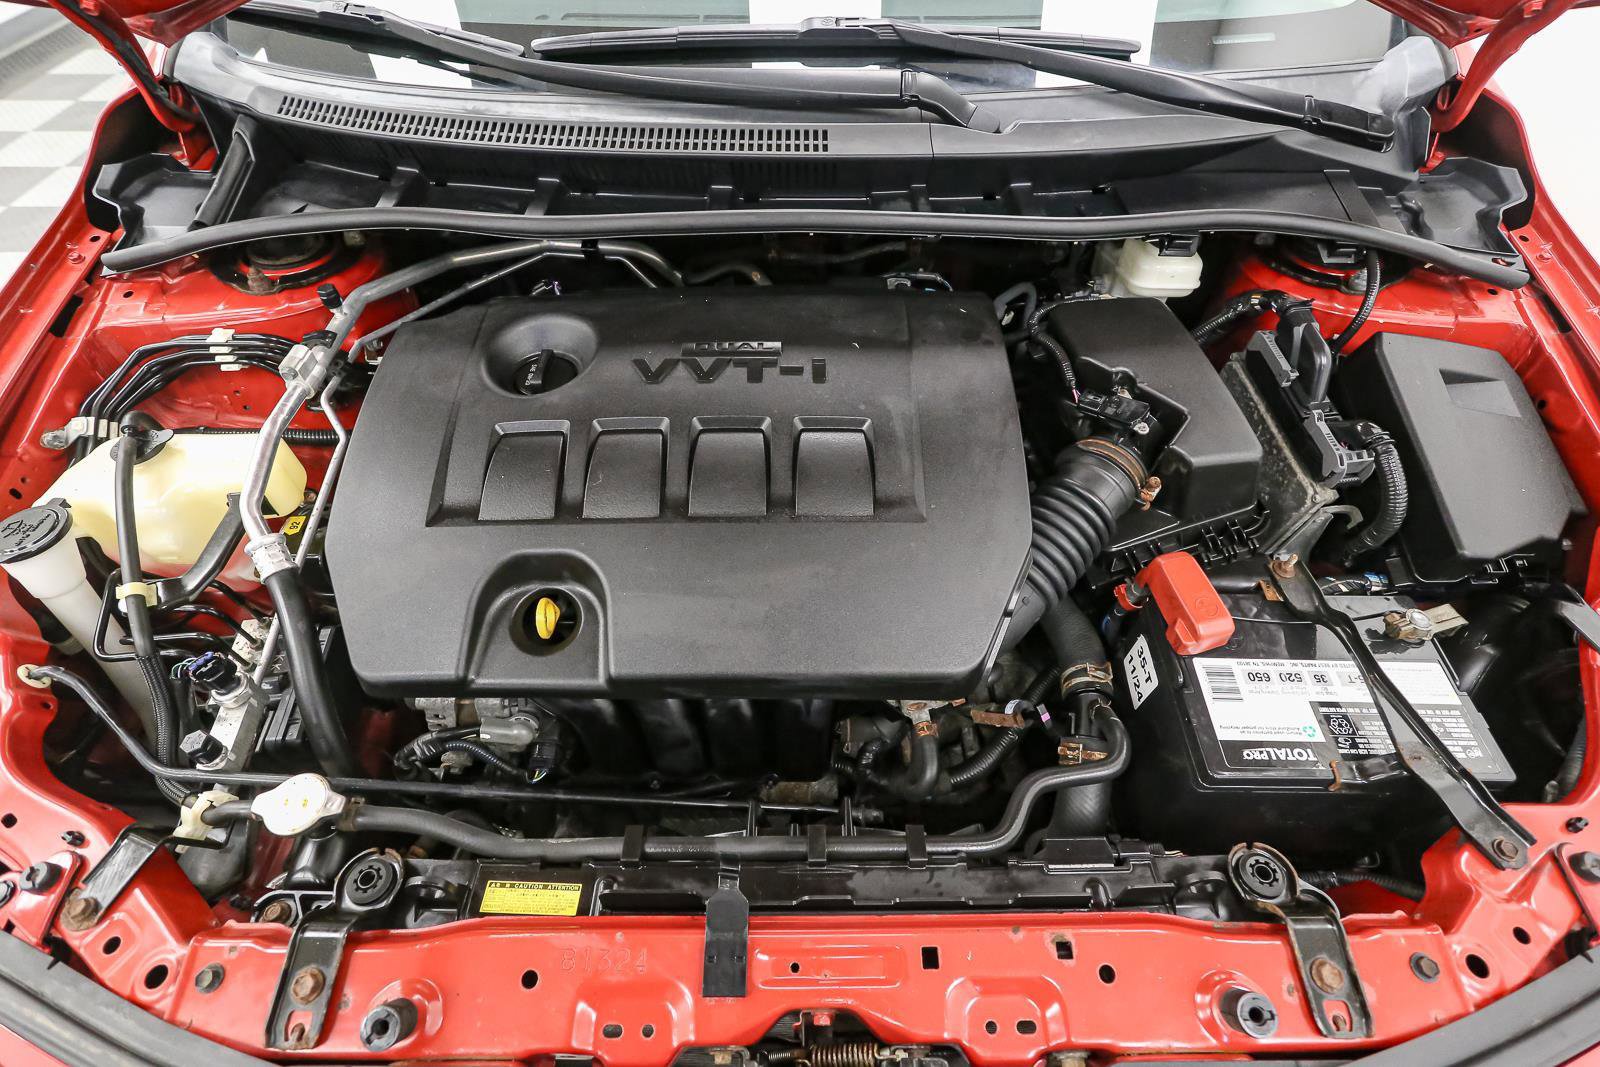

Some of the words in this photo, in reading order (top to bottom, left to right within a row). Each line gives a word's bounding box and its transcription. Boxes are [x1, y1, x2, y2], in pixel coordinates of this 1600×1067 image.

[1137, 646, 1152, 684] 35-T
[1128, 654, 1143, 702] 11/24
[1247, 672, 1271, 682] 650
[1279, 672, 1303, 683] 520
[1313, 674, 1328, 684] 35
[1241, 747, 1318, 761] TOTALPRO
